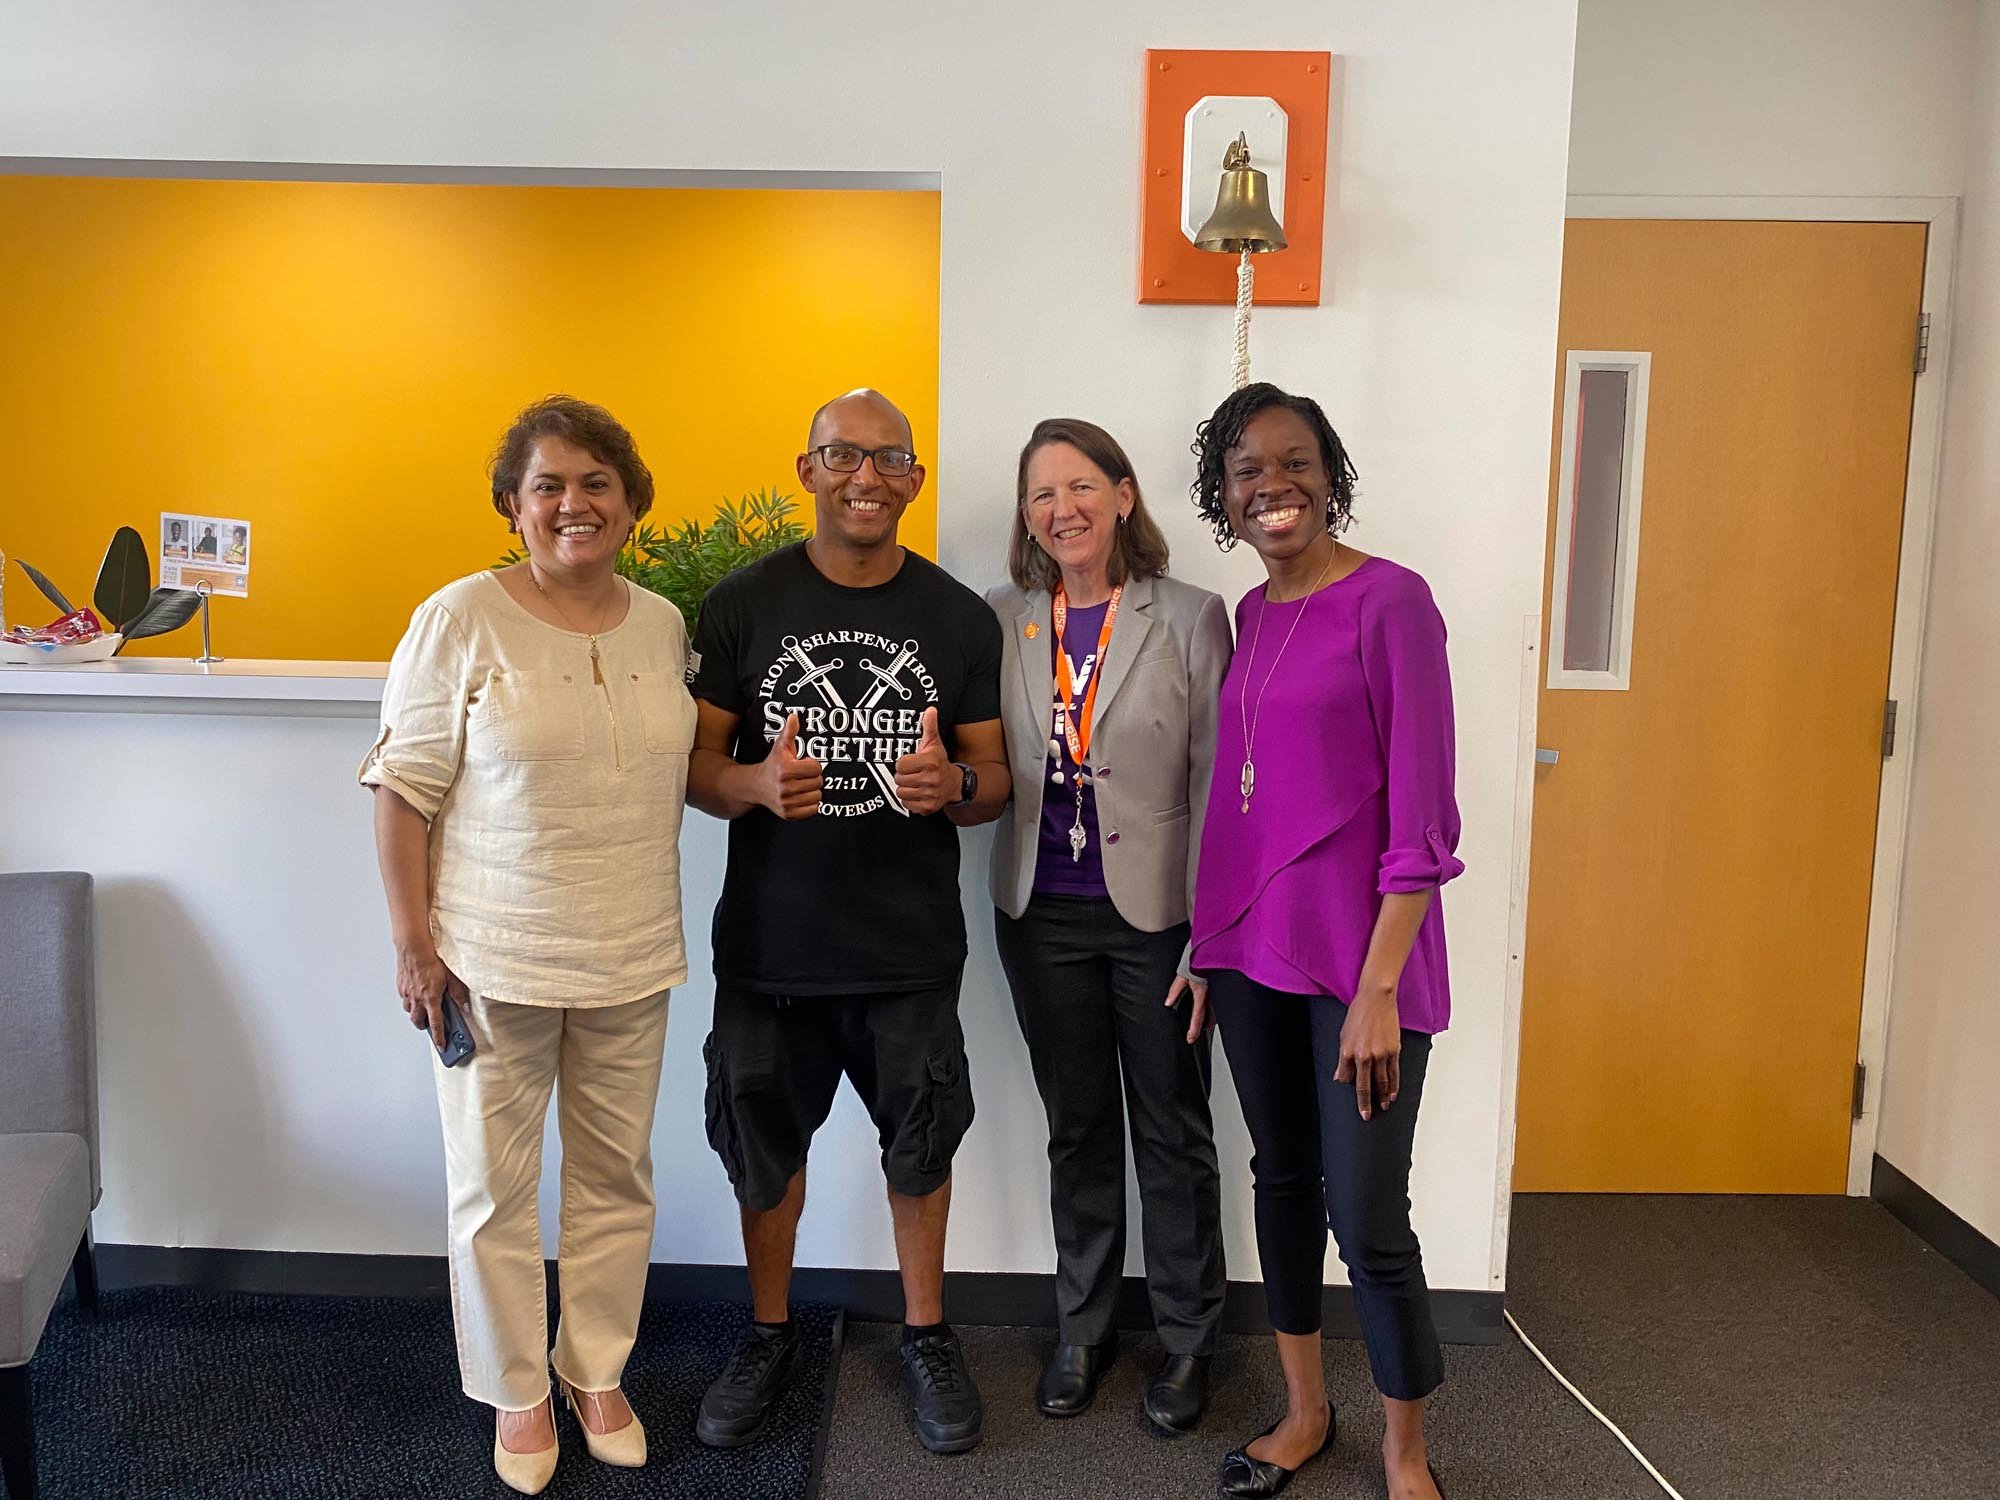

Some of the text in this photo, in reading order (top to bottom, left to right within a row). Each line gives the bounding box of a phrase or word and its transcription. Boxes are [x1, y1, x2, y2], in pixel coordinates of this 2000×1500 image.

[759, 631, 938, 702] IRON SHARPENS IRON
[824, 777, 868, 790] 27:17
